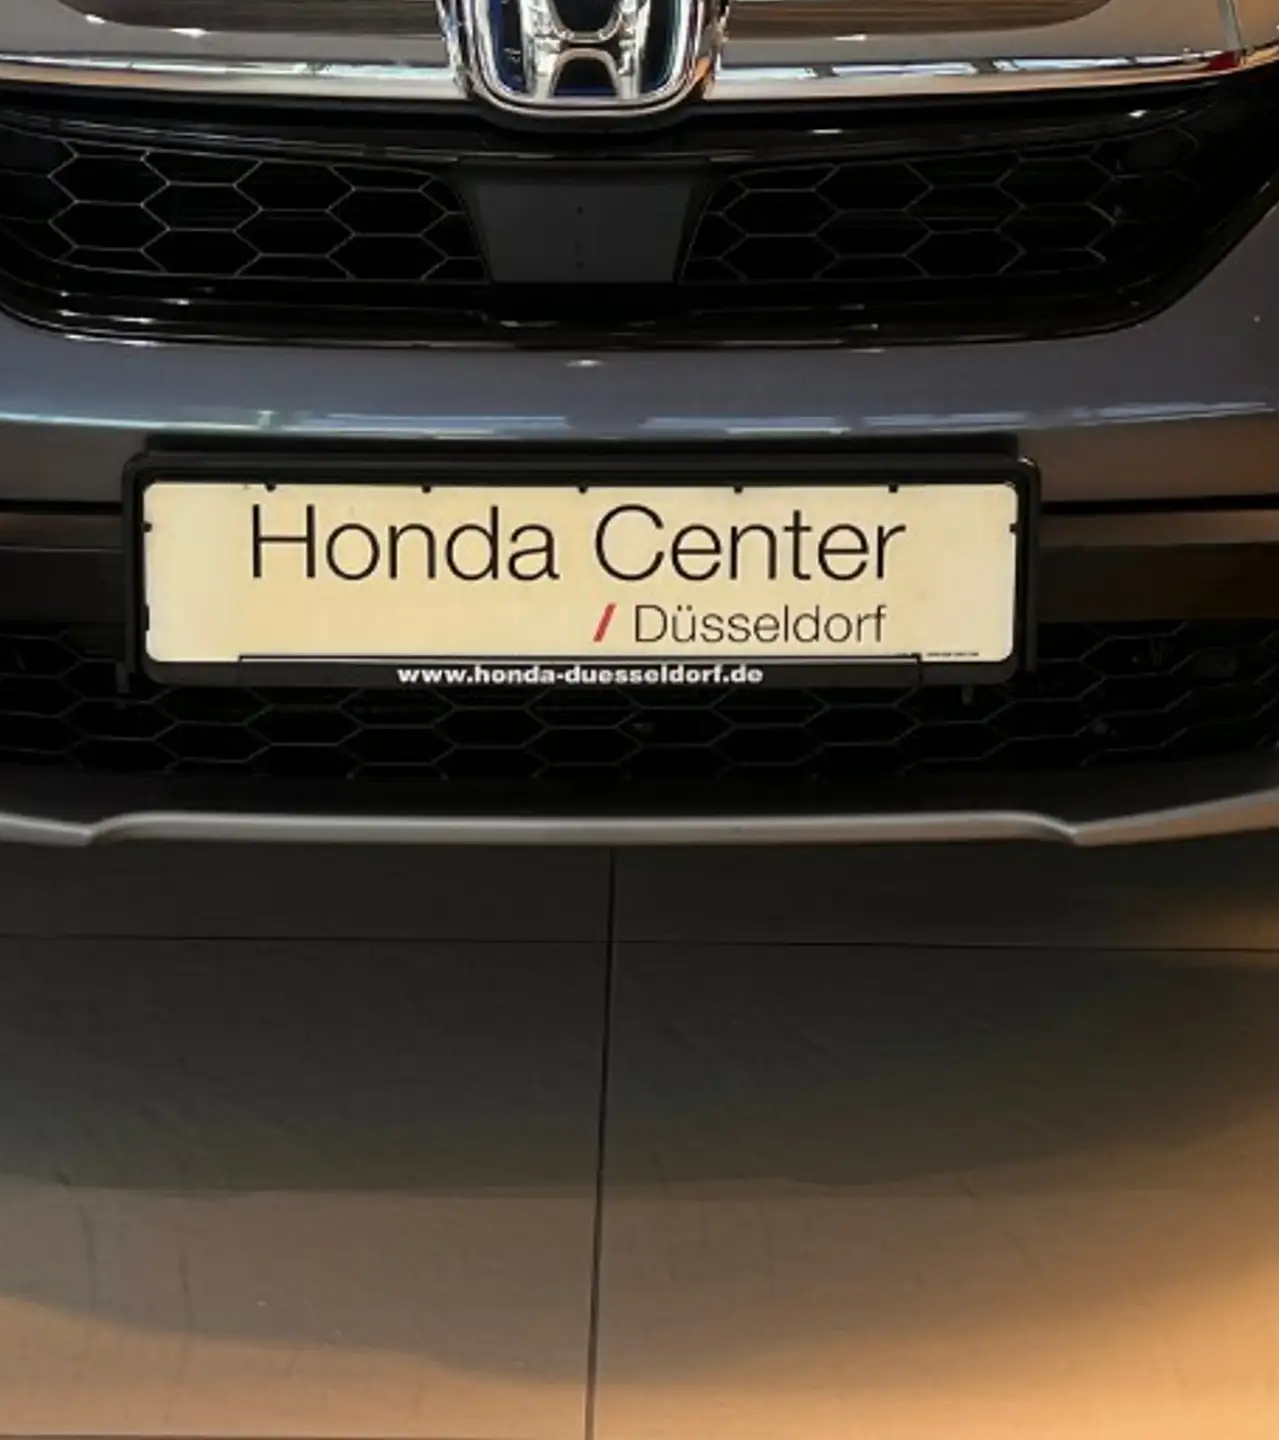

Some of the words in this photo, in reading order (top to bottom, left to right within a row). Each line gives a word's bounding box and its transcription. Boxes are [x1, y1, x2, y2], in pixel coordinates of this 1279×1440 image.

[251, 503, 560, 582] Honda
[594, 503, 907, 582] Center
[634, 604, 888, 643] Düsseldorf
[397, 664, 765, 684] www.honda-duesseldorf.de
